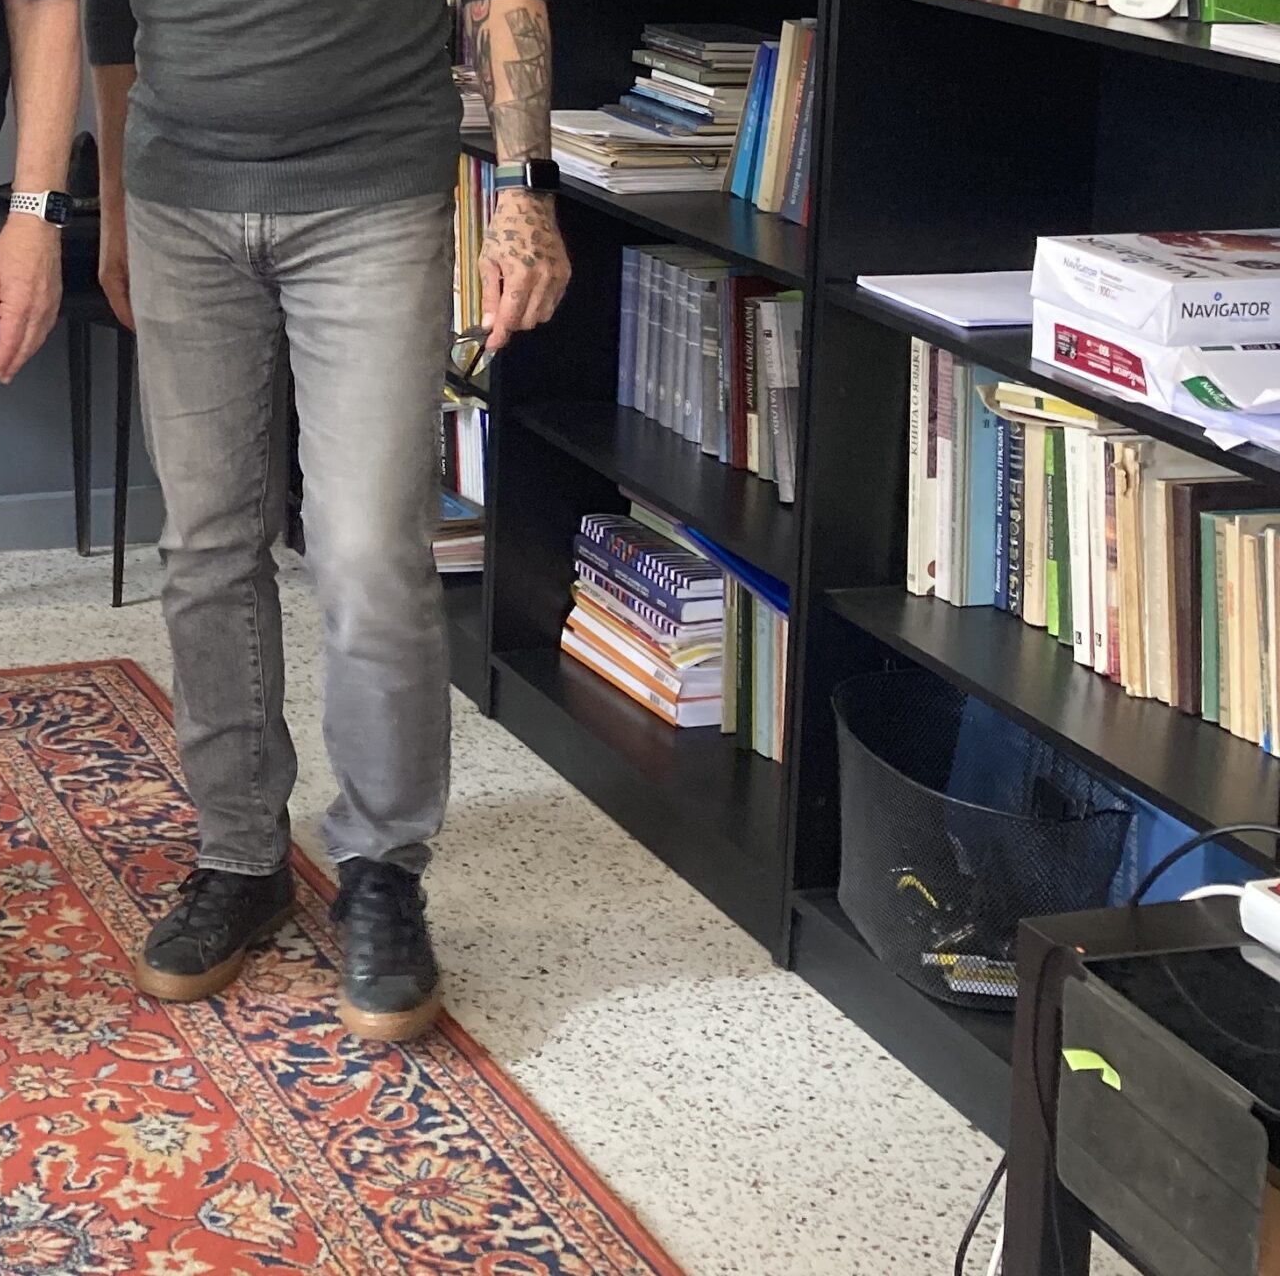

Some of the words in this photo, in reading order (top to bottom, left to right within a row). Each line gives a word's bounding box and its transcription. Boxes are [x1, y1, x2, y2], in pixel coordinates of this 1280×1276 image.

[1181, 300, 1271, 319] NAVIGATOR
[910, 344, 921, 395] ЯЗЫКЕ
[910, 409, 920, 456] КНИГА
